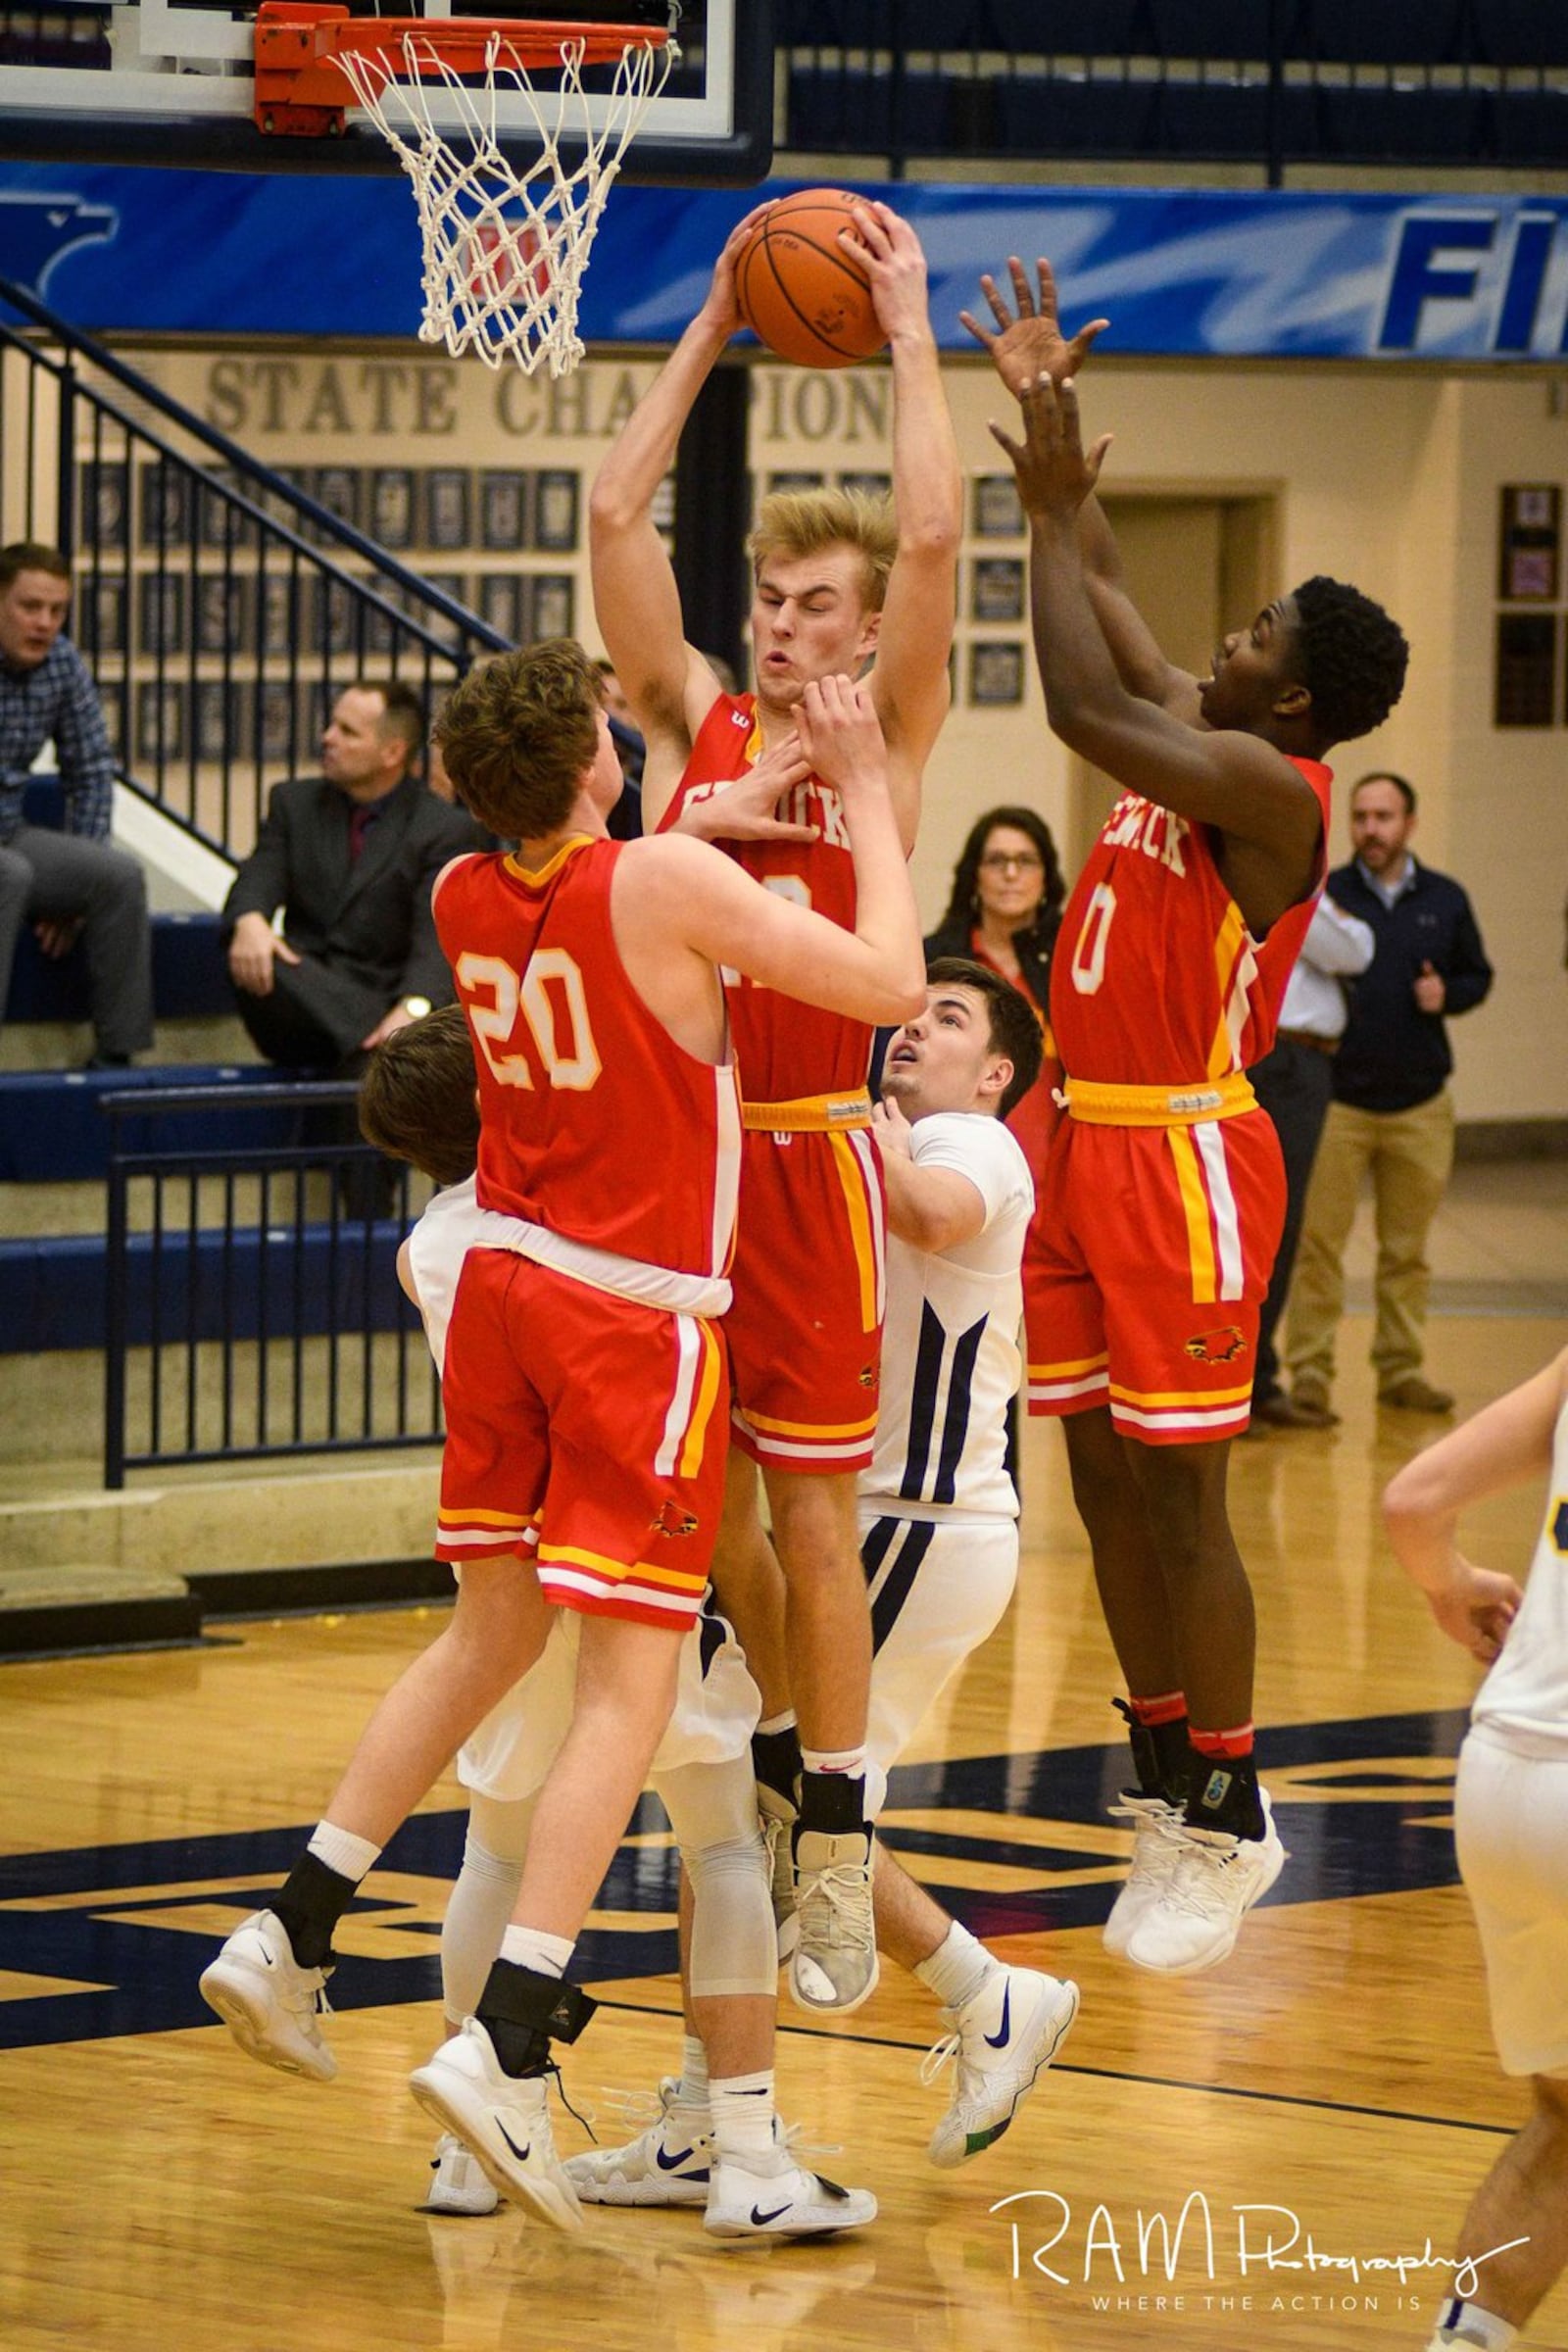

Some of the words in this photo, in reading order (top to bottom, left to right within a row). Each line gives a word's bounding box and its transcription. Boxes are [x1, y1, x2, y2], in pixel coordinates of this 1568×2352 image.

[1374, 210, 1568, 352] FI
[204, 359, 459, 435] STATE
[1071, 880, 1118, 996] 0
[455, 947, 604, 1092] 20
